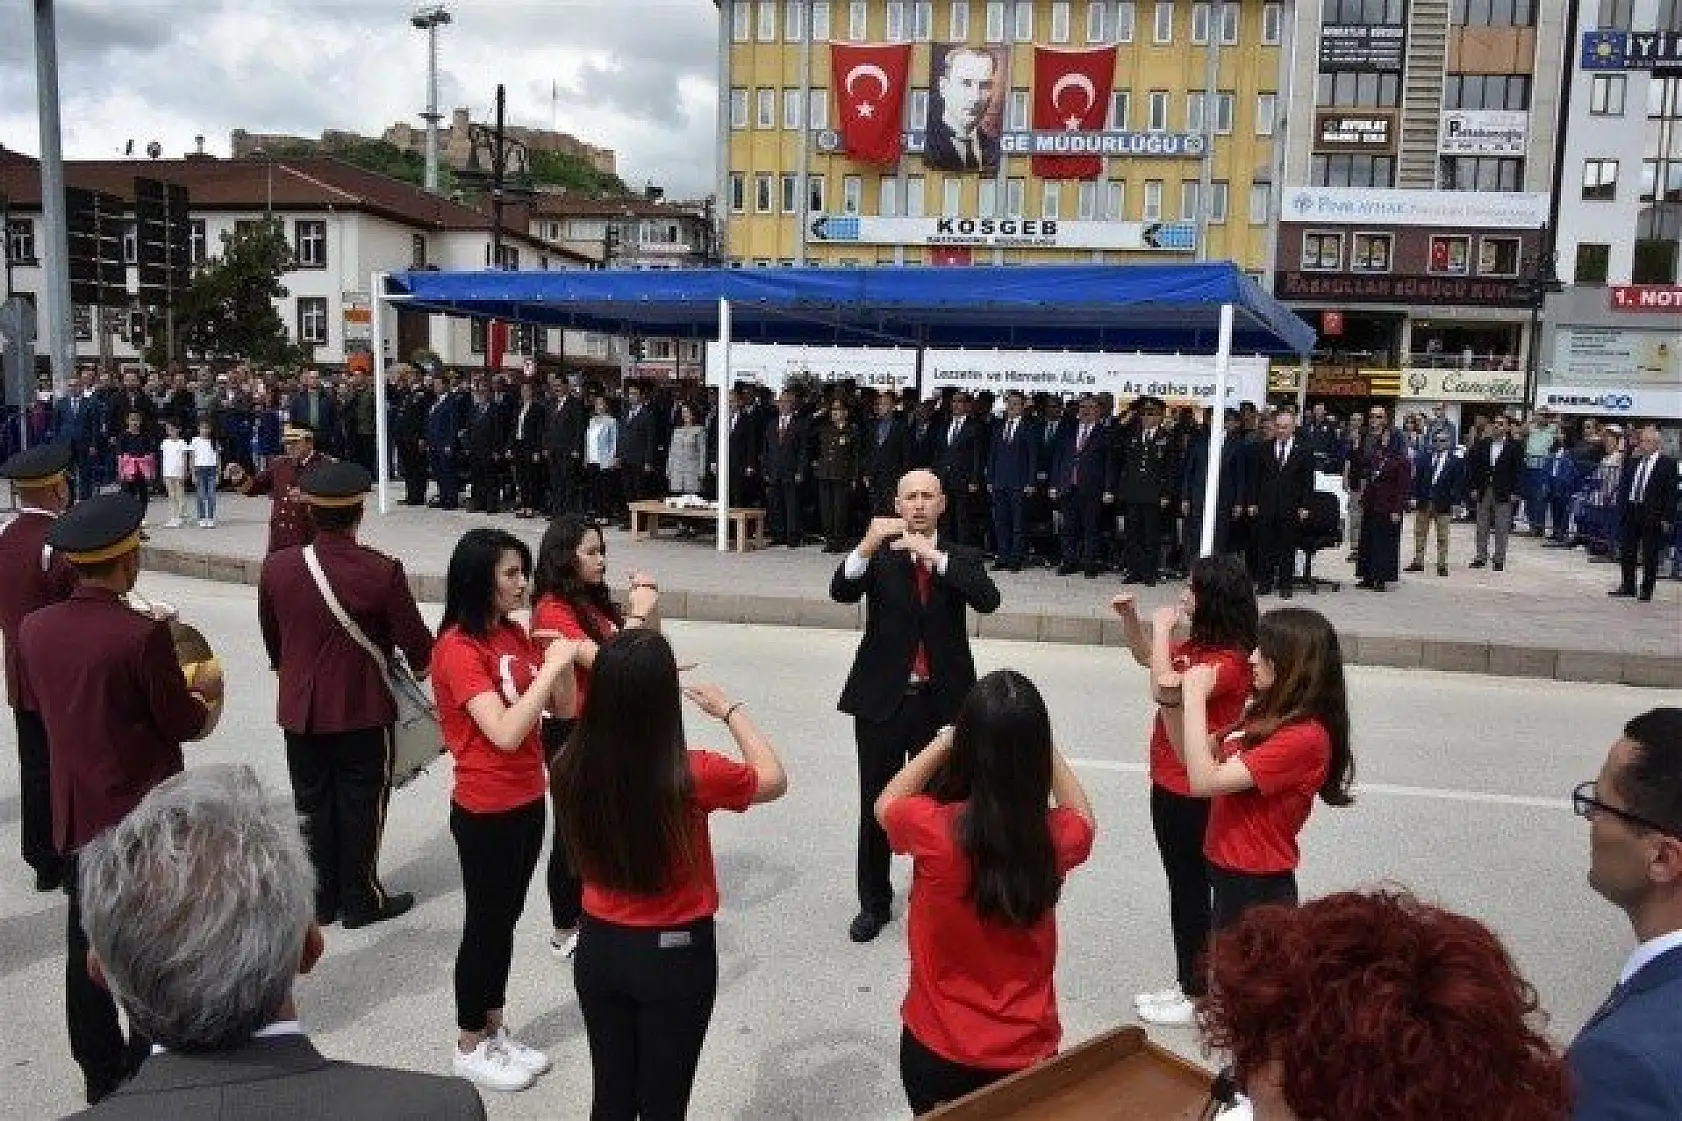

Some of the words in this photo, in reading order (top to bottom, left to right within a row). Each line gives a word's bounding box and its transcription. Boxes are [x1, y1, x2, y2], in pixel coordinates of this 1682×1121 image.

[937, 218, 1058, 235] KOSGEB
[1615, 289, 1634, 306] 1.
[986, 373, 1001, 383] ve
[1123, 380, 1143, 393] Az
[1147, 381, 1188, 396] daha
